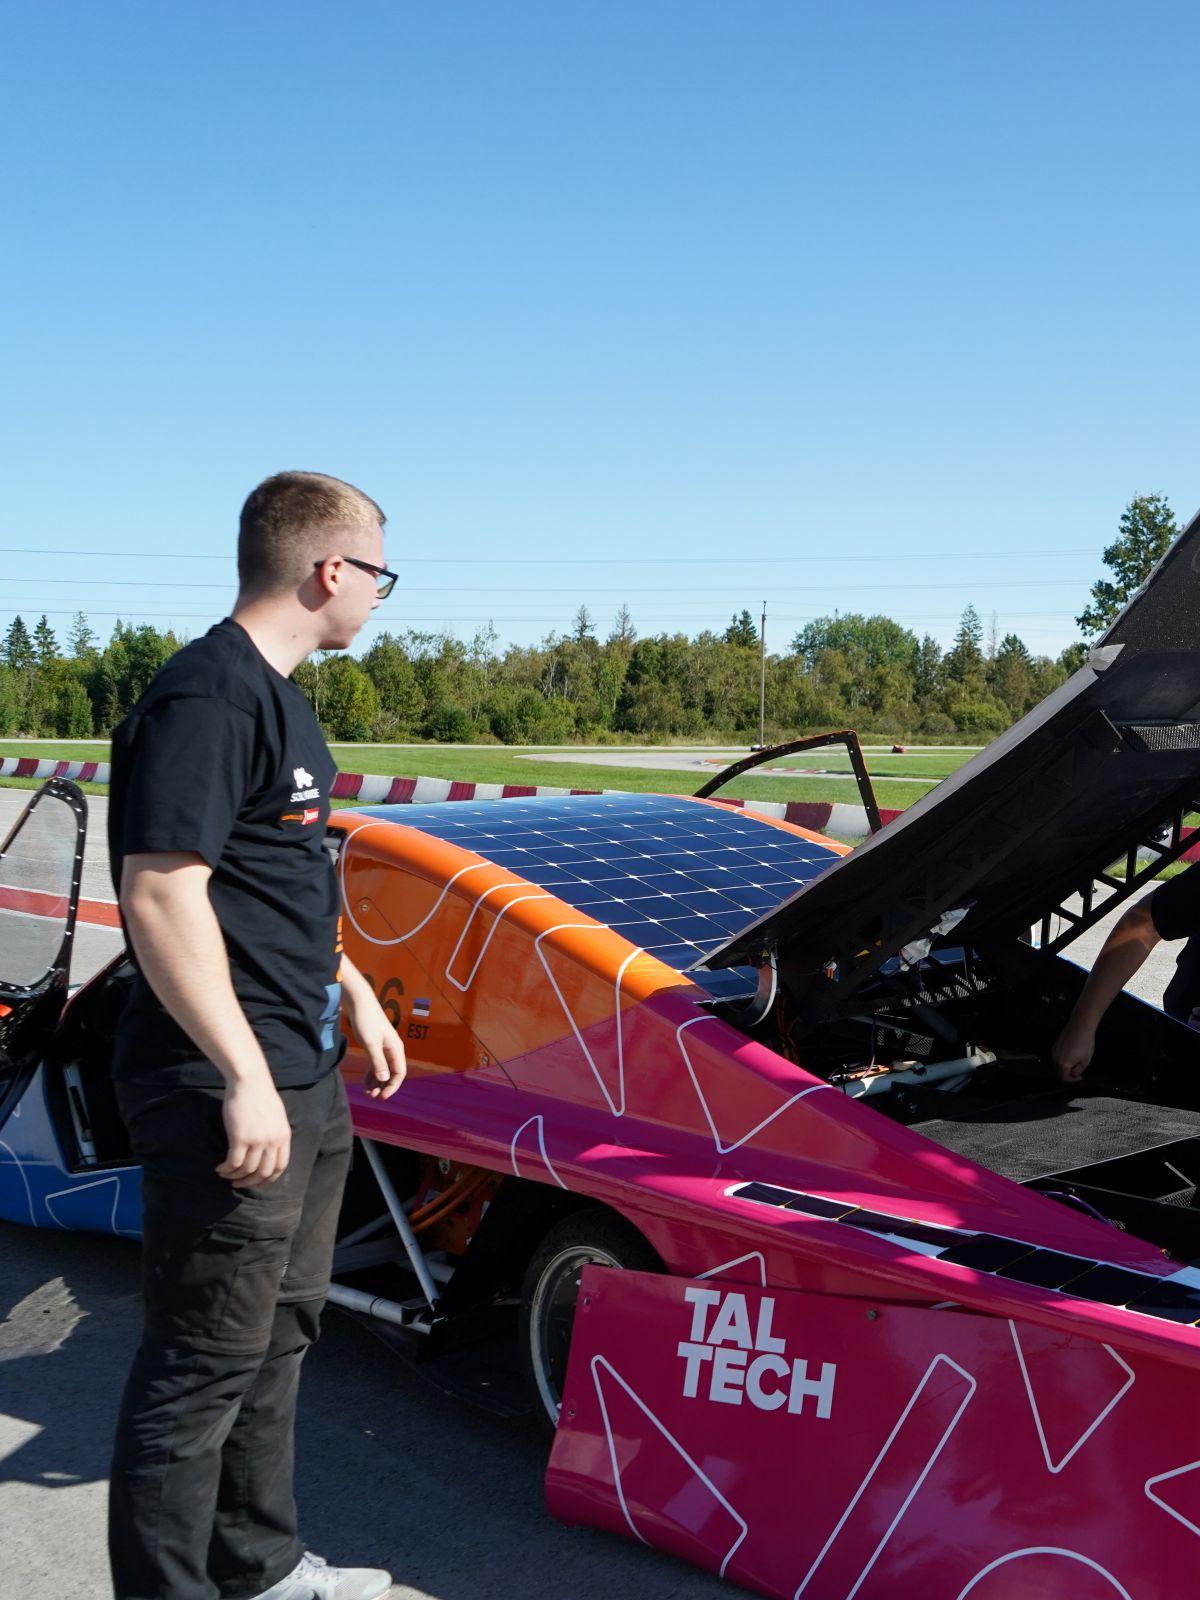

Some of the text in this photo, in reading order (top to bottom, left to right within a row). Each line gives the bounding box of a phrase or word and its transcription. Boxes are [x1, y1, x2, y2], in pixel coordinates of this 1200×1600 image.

[407, 1023, 430, 1041] EST
[684, 1287, 787, 1354] TAL
[677, 1341, 837, 1420] TECH
